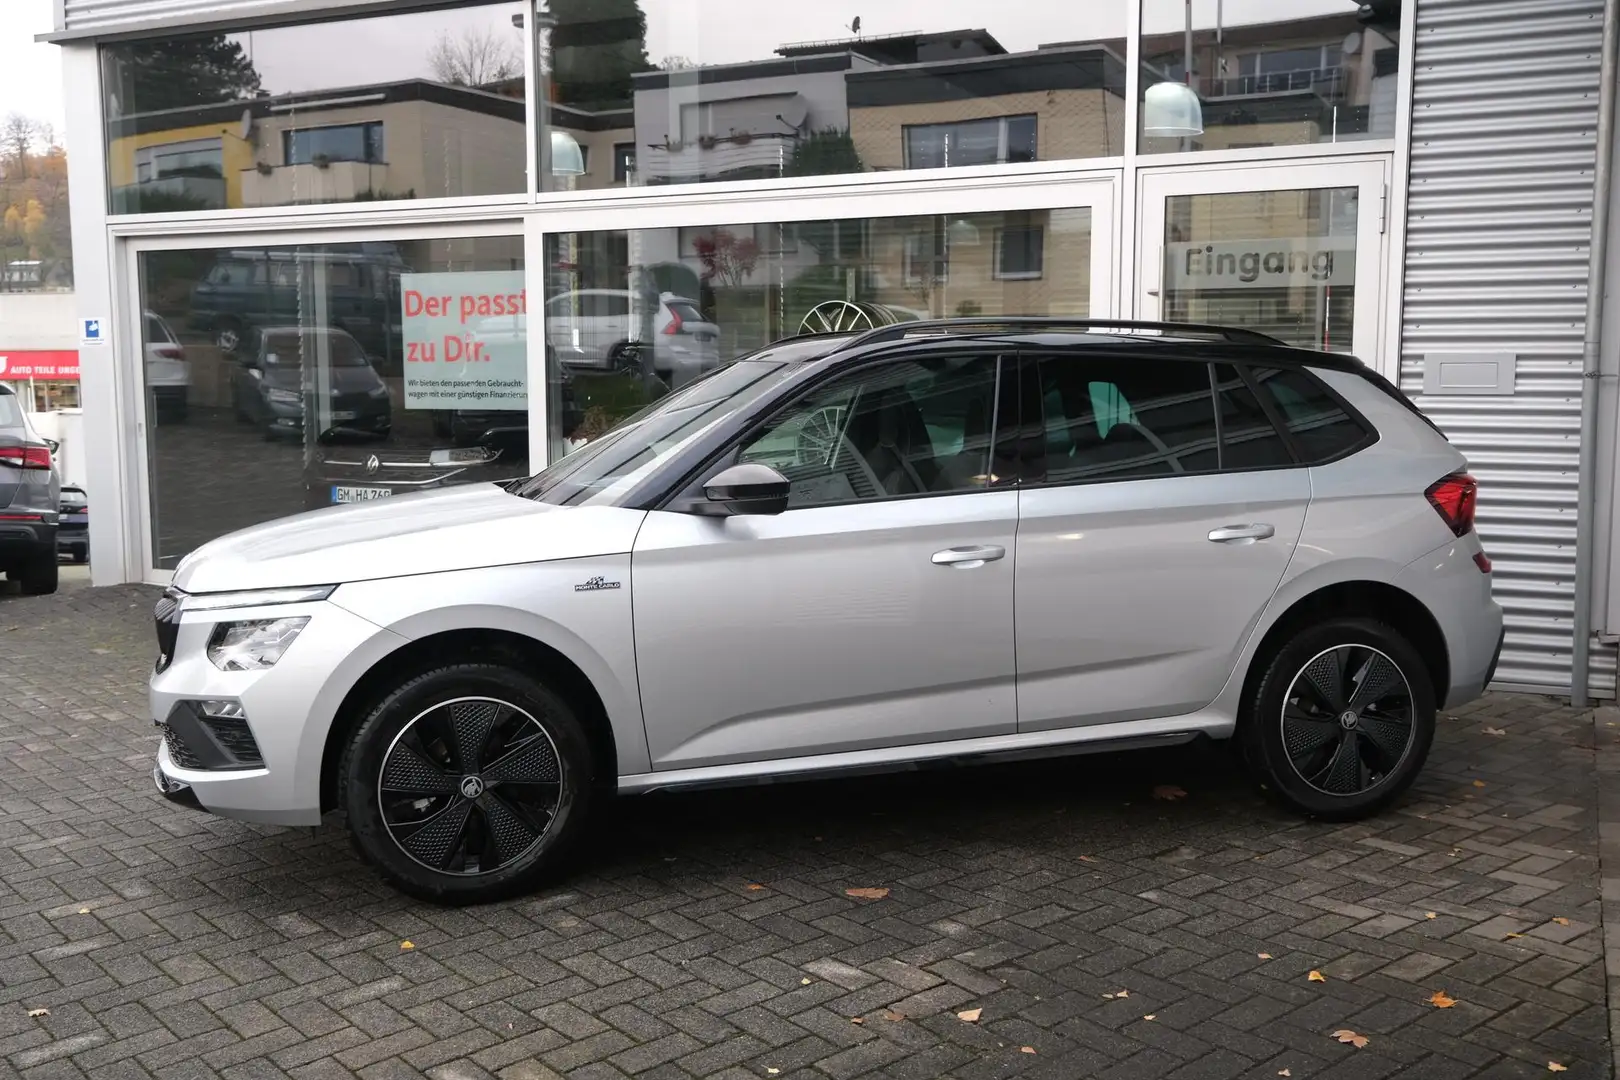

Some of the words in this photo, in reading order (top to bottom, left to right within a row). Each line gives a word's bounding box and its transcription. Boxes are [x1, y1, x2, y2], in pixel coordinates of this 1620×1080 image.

[1186, 245, 1334, 282] Eingang
[404, 290, 452, 317] Der
[460, 288, 526, 324] passt
[407, 342, 435, 362] zu
[444, 331, 491, 363] Dir.
[10, 366, 32, 374] AUTO
[34, 366, 56, 374] TEILE
[420, 379, 439, 387] bieten
[441, 379, 452, 387] den
[453, 380, 486, 388] passenden
[487, 379, 524, 387] Gebraucht-
[408, 391, 428, 399] wagen
[457, 390, 488, 400] günstigen
[337, 488, 350, 501] GM
[355, 489, 368, 501] HA
